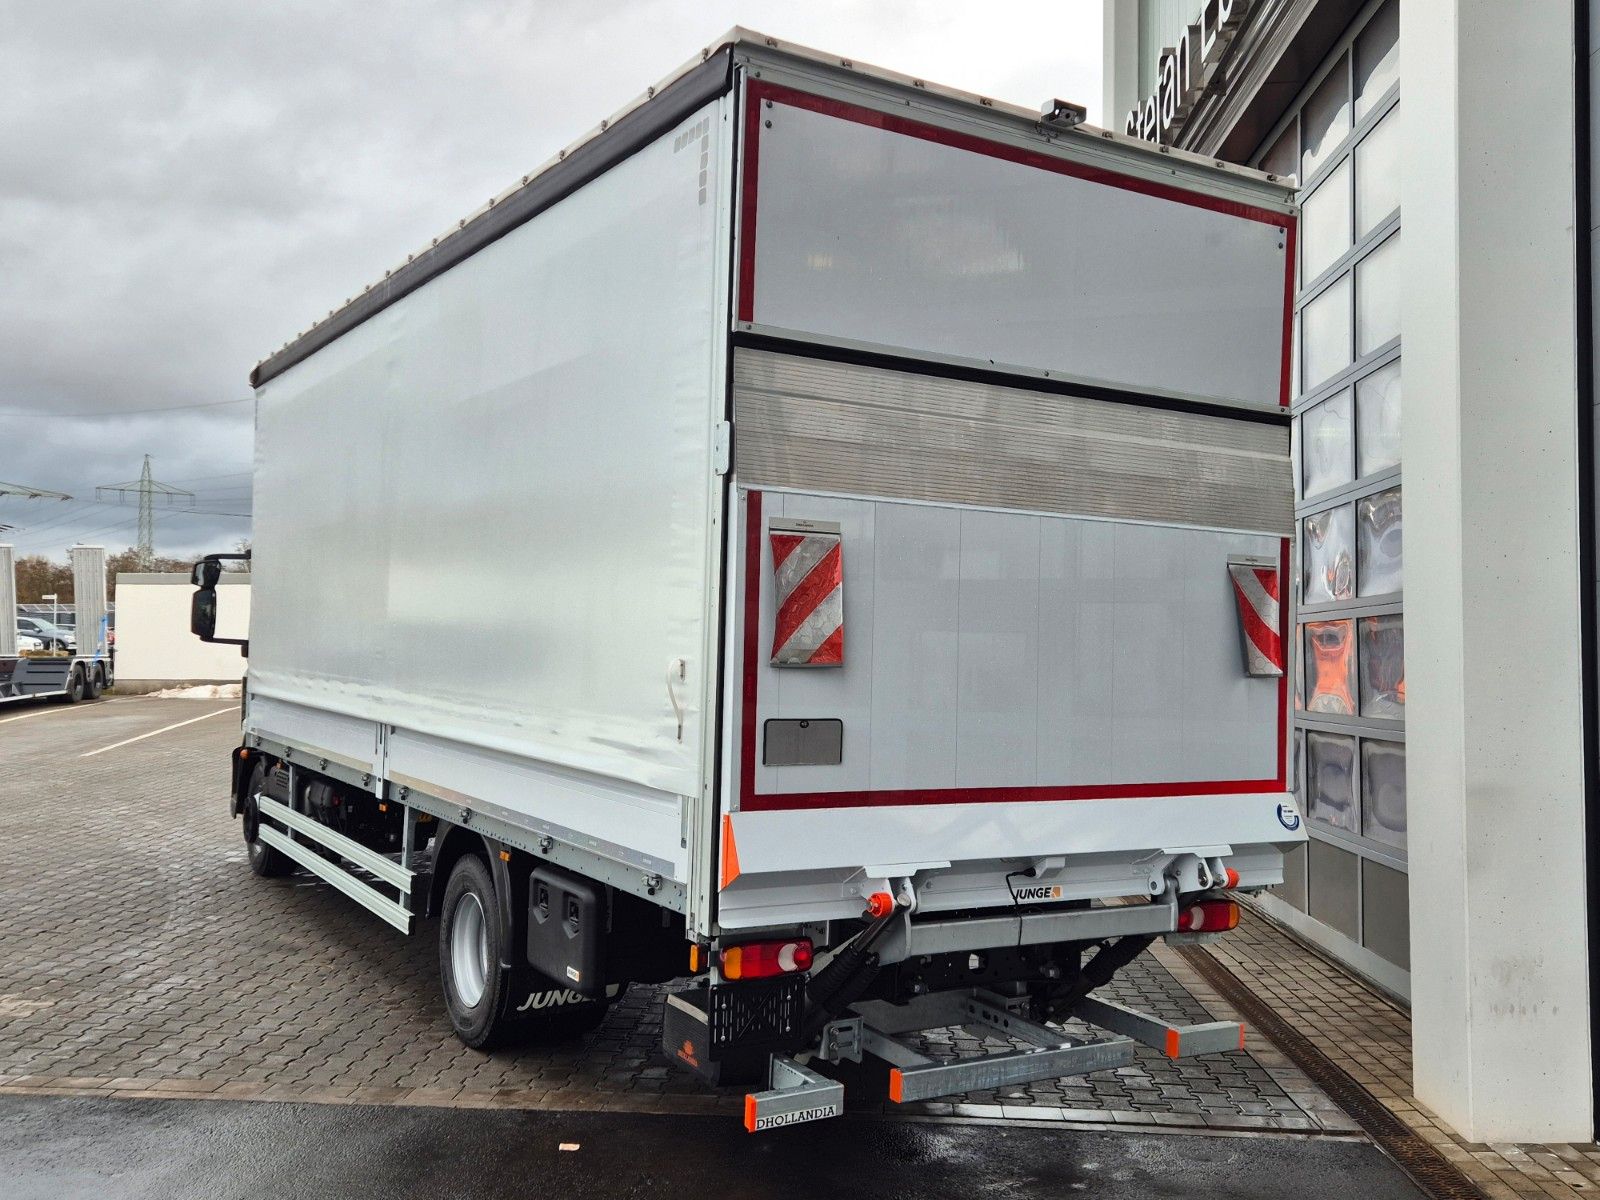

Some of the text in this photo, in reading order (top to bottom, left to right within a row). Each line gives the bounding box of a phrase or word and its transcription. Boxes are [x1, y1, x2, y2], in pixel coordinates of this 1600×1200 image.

[1013, 887, 1052, 900] JUNGE
[516, 988, 597, 1012] JUNG
[756, 1106, 835, 1130] DHOLLANDIA
